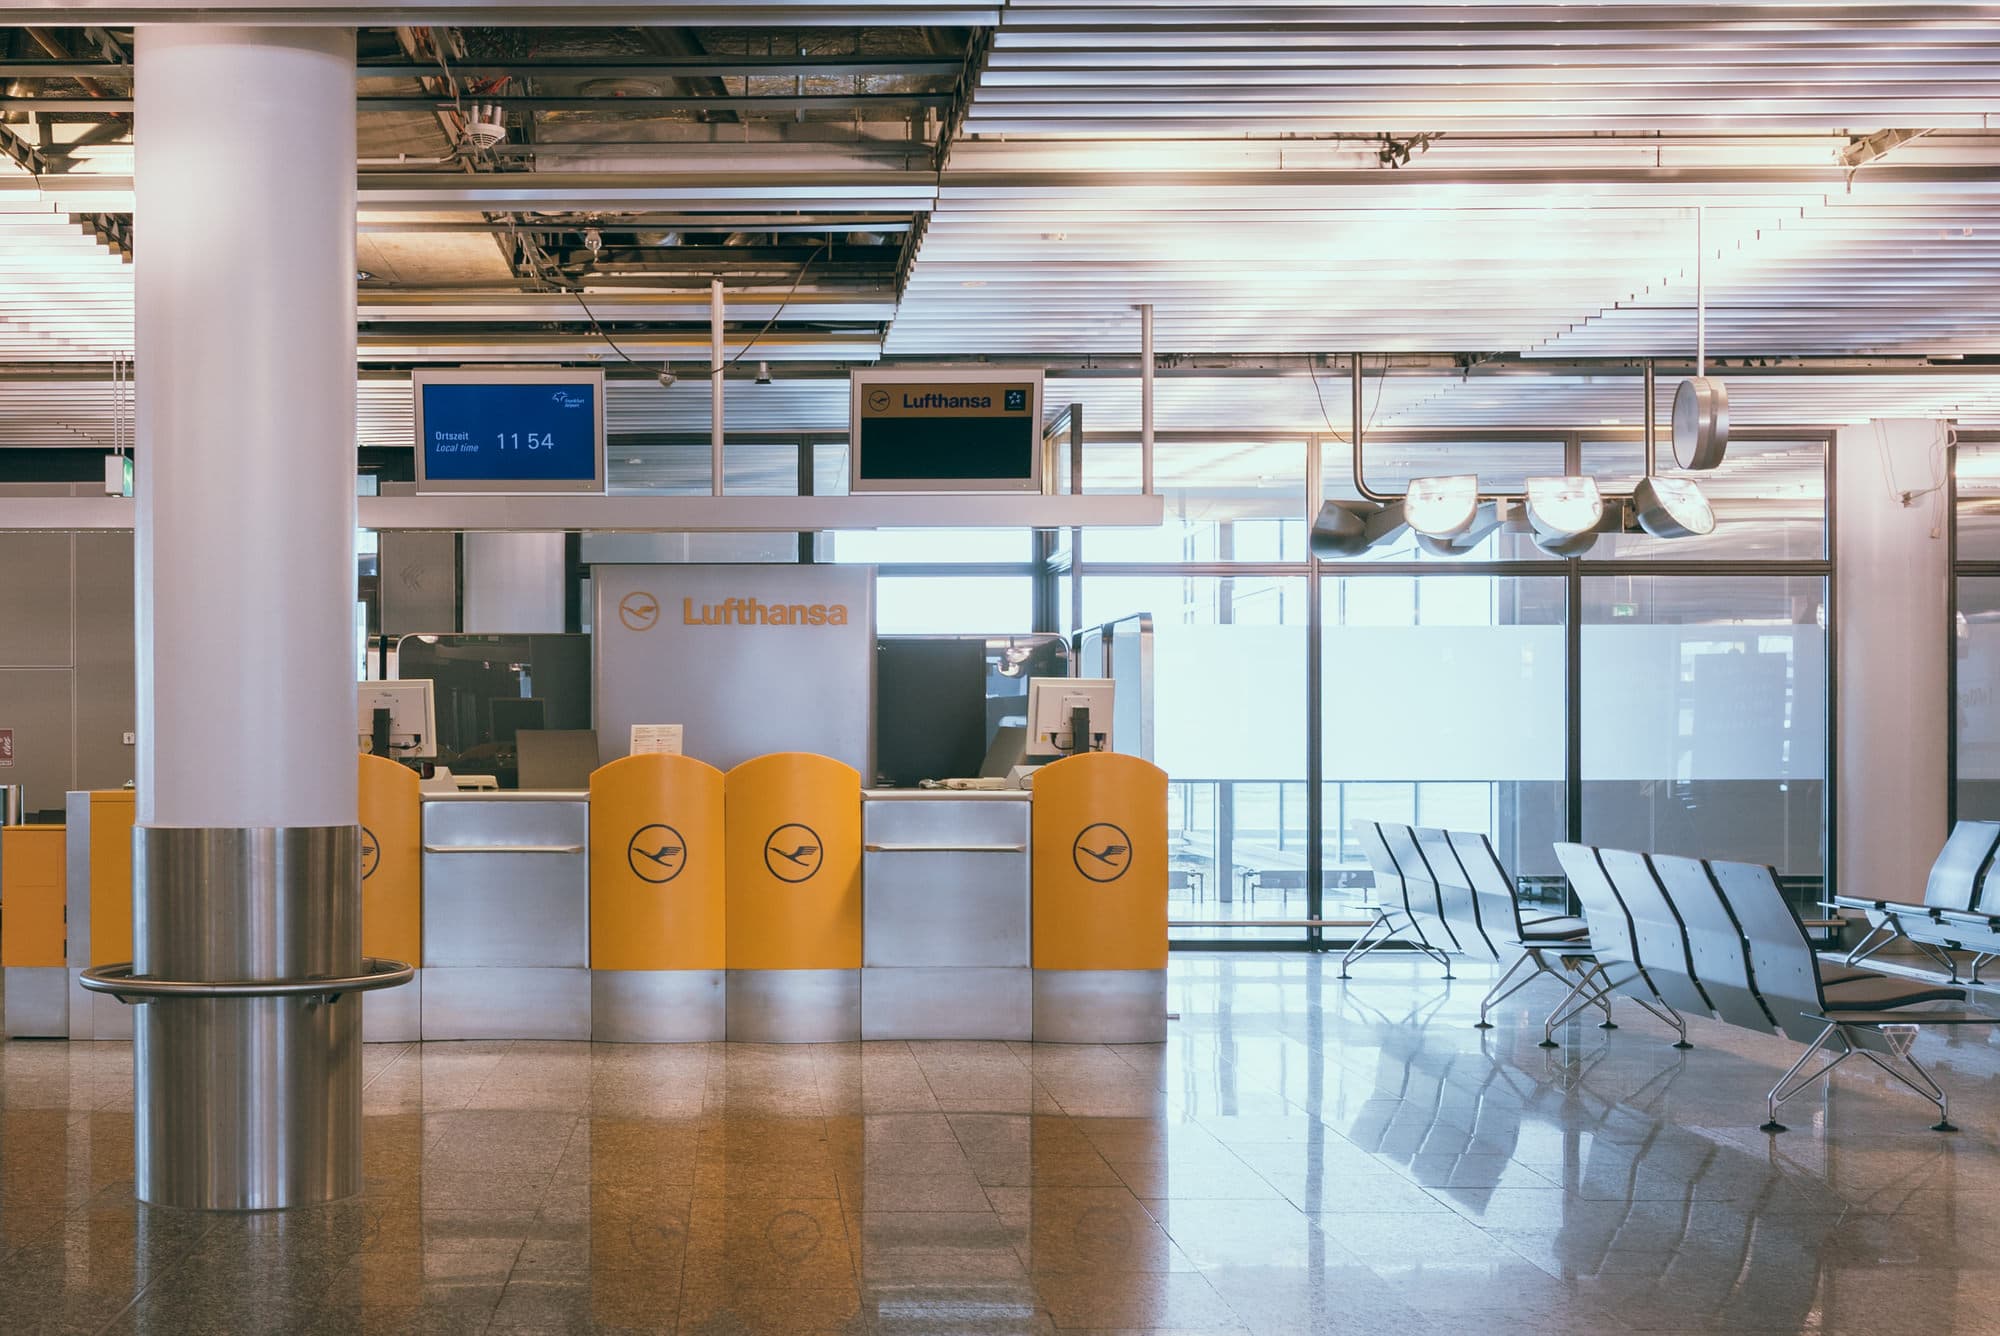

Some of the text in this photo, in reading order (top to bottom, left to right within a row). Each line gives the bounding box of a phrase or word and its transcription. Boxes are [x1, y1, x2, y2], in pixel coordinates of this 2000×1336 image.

[903, 393, 992, 408] Lufthansa
[435, 431, 469, 440] Ortszeit
[436, 443, 479, 452] Local time
[683, 597, 848, 625] Lufthansa
